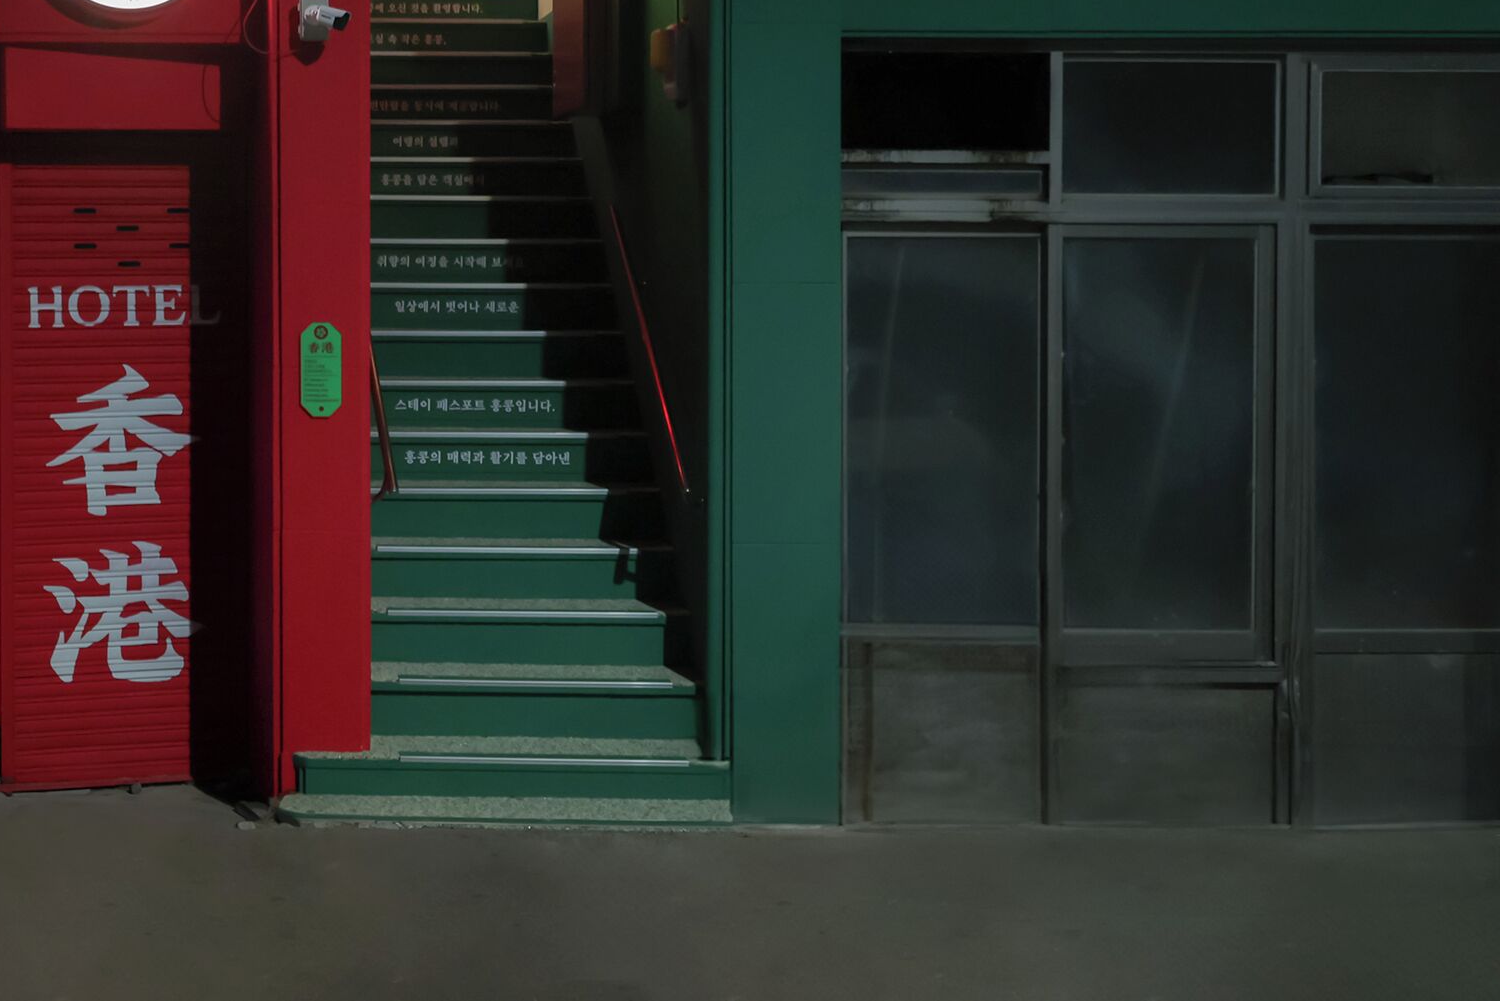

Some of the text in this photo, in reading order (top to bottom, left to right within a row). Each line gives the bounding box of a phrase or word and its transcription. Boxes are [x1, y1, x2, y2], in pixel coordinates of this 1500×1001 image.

[27, 283, 221, 330] HOTEL
[395, 300, 520, 313] 일상에서 벗어나 새로운
[395, 398, 556, 412] 스테이 패스포트 홍콩입니다.
[404, 450, 571, 465] 홍콩의 매력과 활기를 담아낸
[44, 364, 203, 683] 香港
